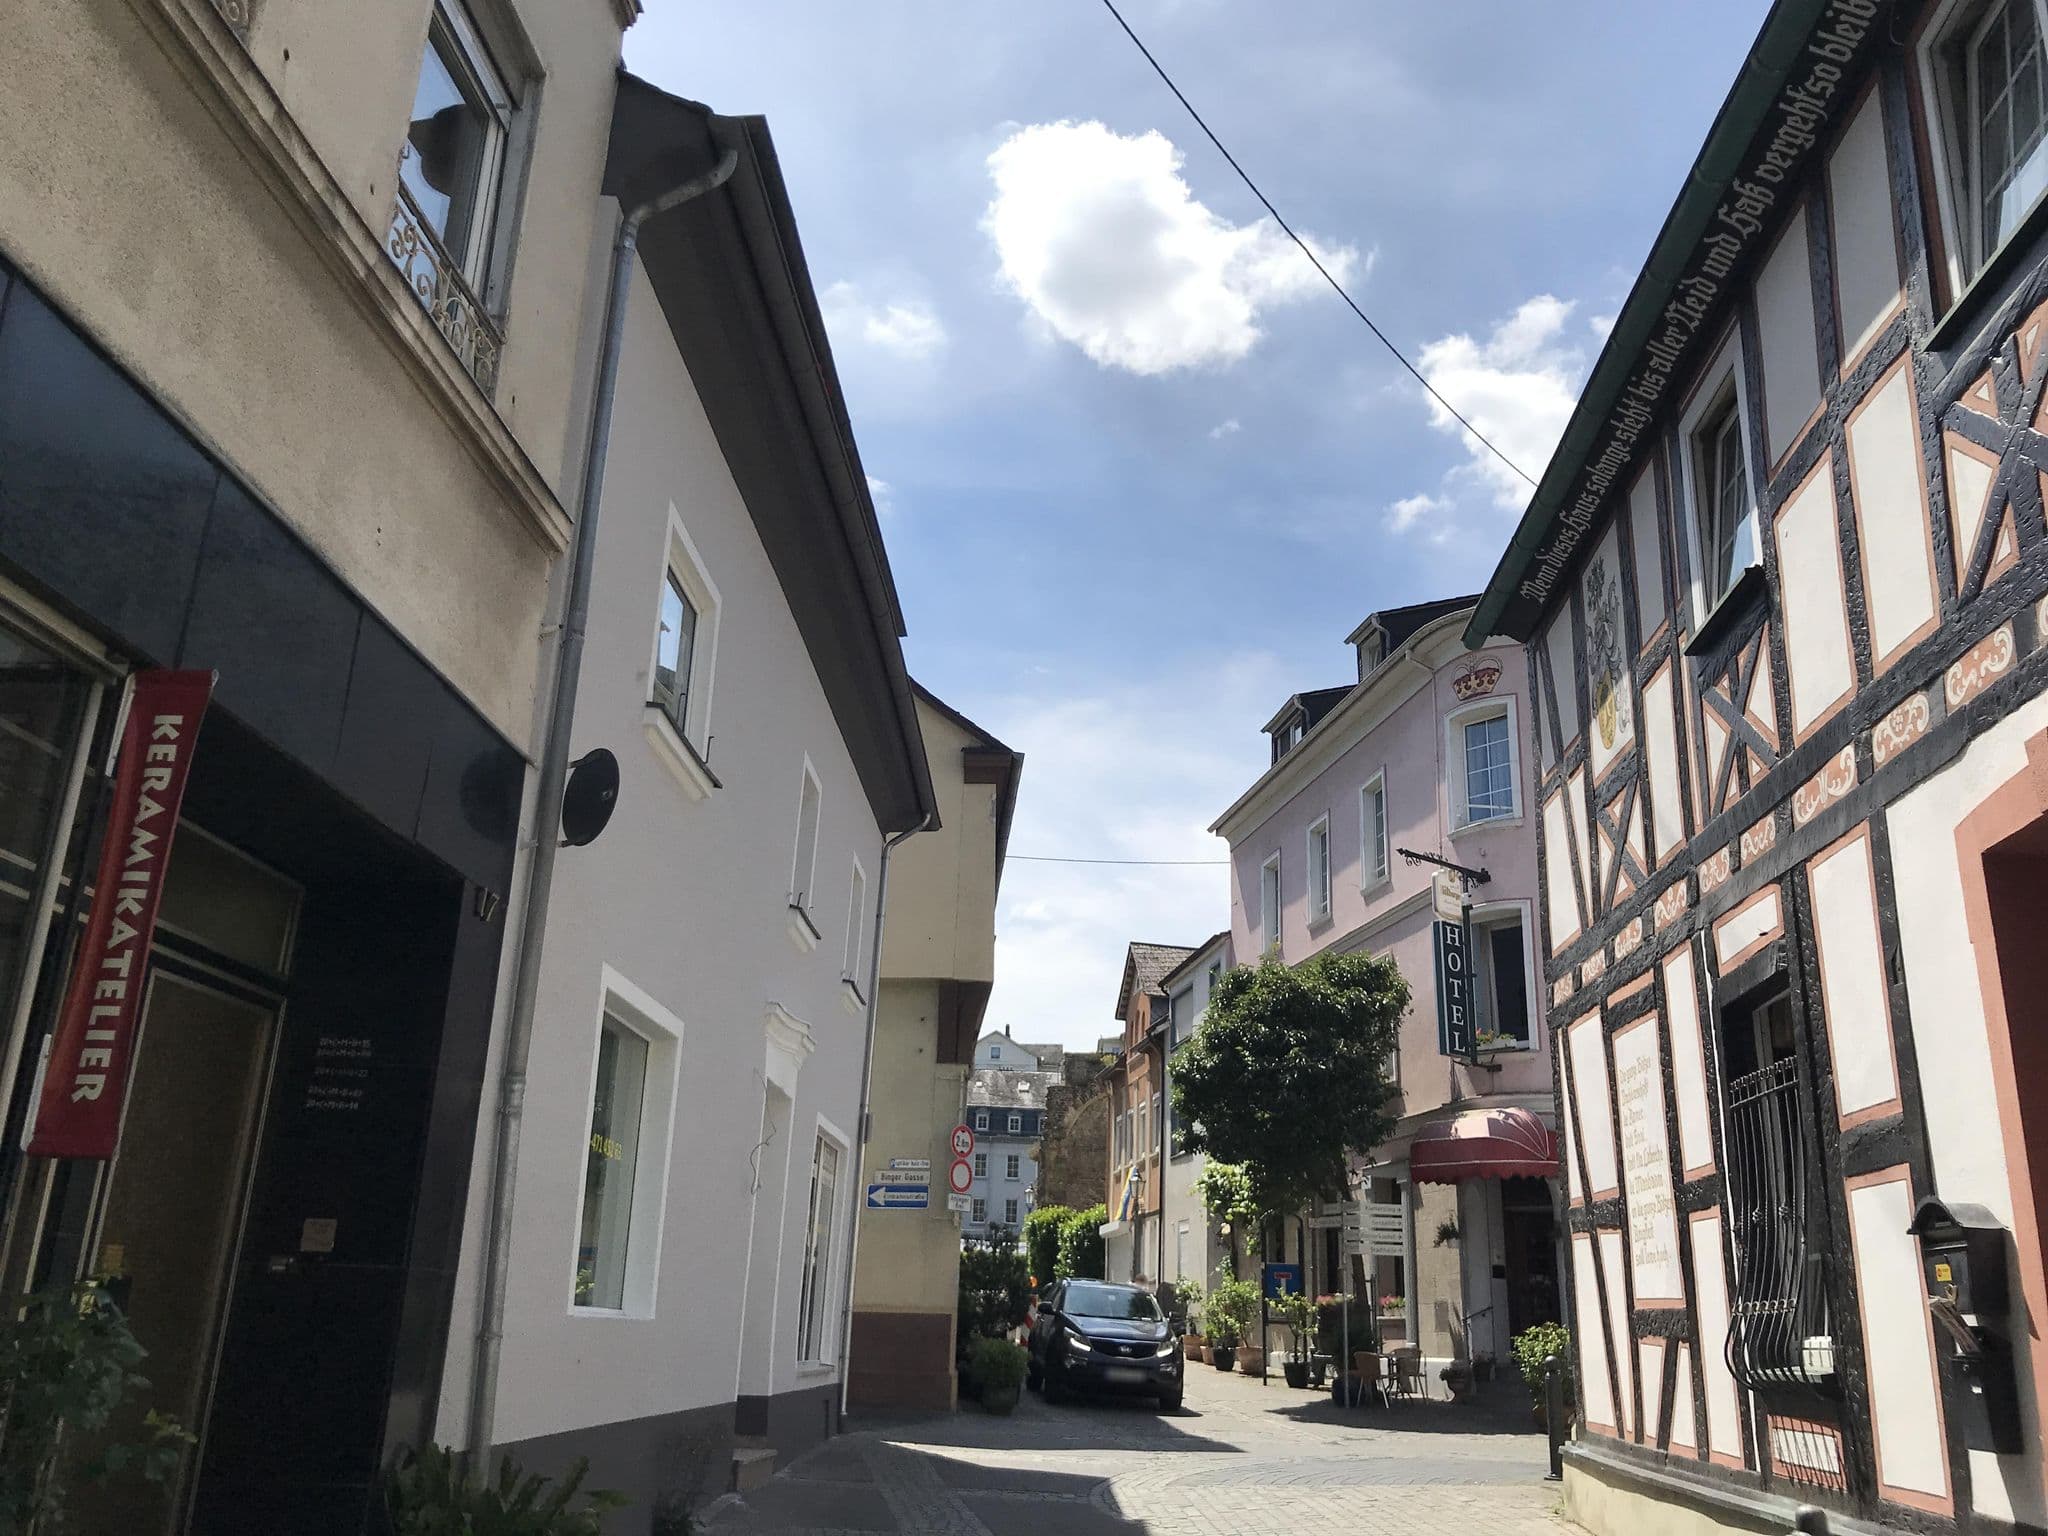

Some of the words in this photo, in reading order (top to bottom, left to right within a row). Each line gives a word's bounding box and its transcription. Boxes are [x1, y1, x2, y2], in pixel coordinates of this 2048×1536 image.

[1809, 0, 1881, 62] bleib
[1804, 63, 1842, 98] so
[1702, 233, 1742, 278] und
[1664, 276, 1718, 332] Neid
[1646, 325, 1688, 373] aller
[1627, 370, 1666, 400] bis
[1610, 397, 1653, 443] steht
[1586, 441, 1631, 496] solange
[1560, 491, 1601, 534] Haus
[1535, 527, 1580, 568] dieses
[1520, 565, 1558, 603] Wenn
[71, 714, 184, 1104] KERAMIKATELIER
[1443, 925, 1466, 1054] HOTEL
[904, 1173, 924, 1181] Gasse
